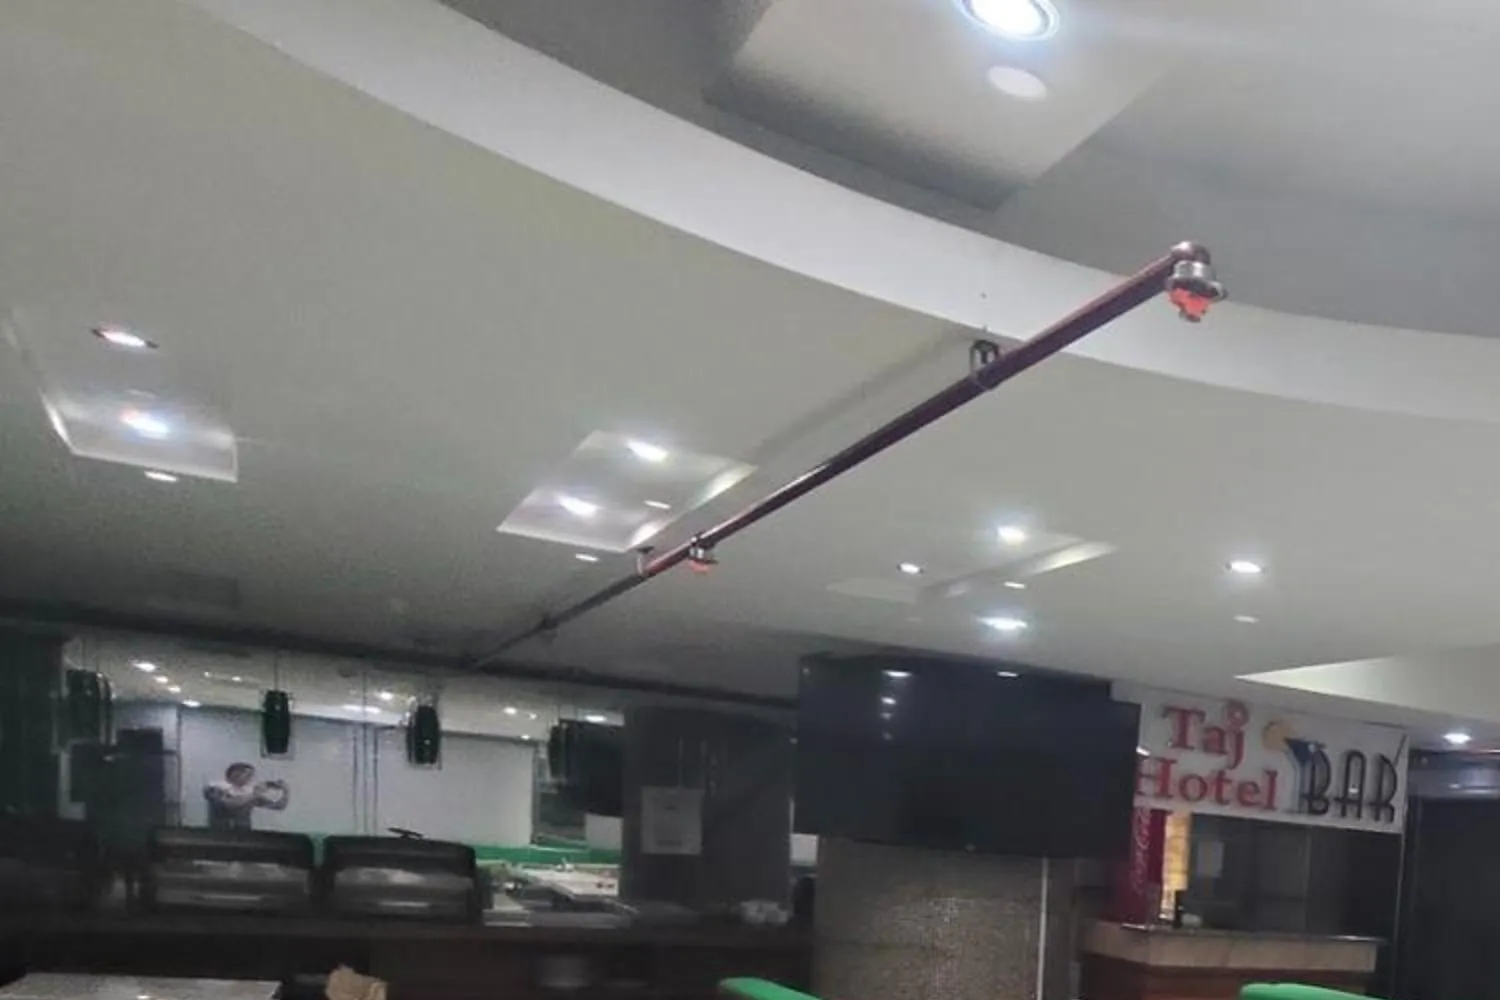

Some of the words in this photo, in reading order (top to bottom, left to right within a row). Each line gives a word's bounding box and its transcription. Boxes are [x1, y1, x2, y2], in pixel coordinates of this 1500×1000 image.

[1162, 700, 1248, 770] Taj
[1136, 756, 1279, 811] Hotel
[1303, 743, 1398, 822] BAR
